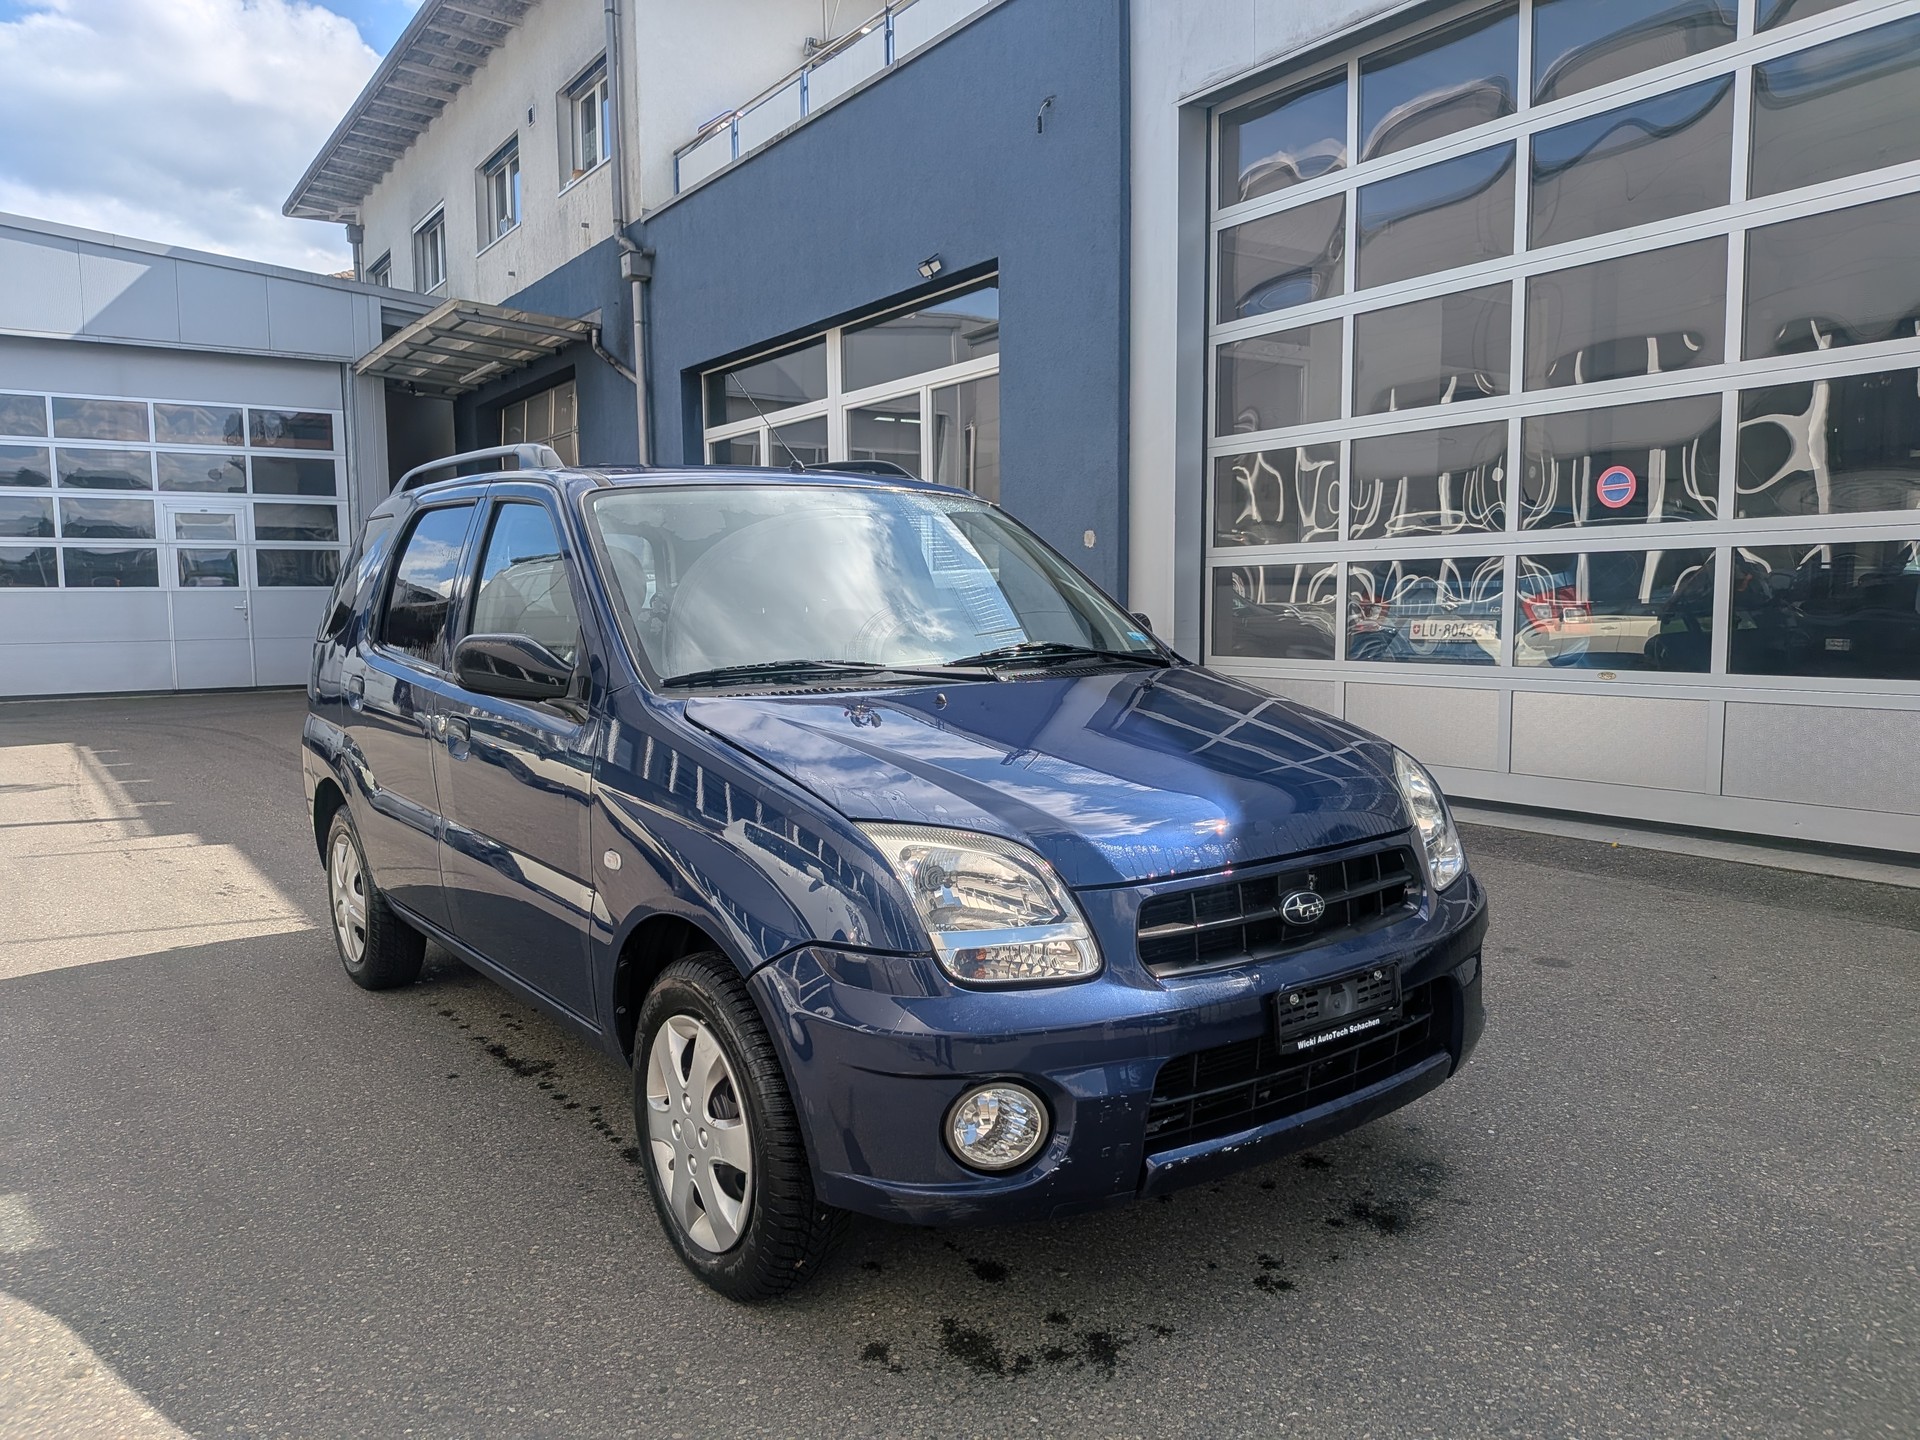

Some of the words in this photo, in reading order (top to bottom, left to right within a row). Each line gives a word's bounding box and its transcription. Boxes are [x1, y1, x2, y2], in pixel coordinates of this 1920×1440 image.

[1297, 1036, 1316, 1050] Wicki
[1317, 1028, 1348, 1043] AutoTech
[1349, 1018, 1380, 1033] Schachen
